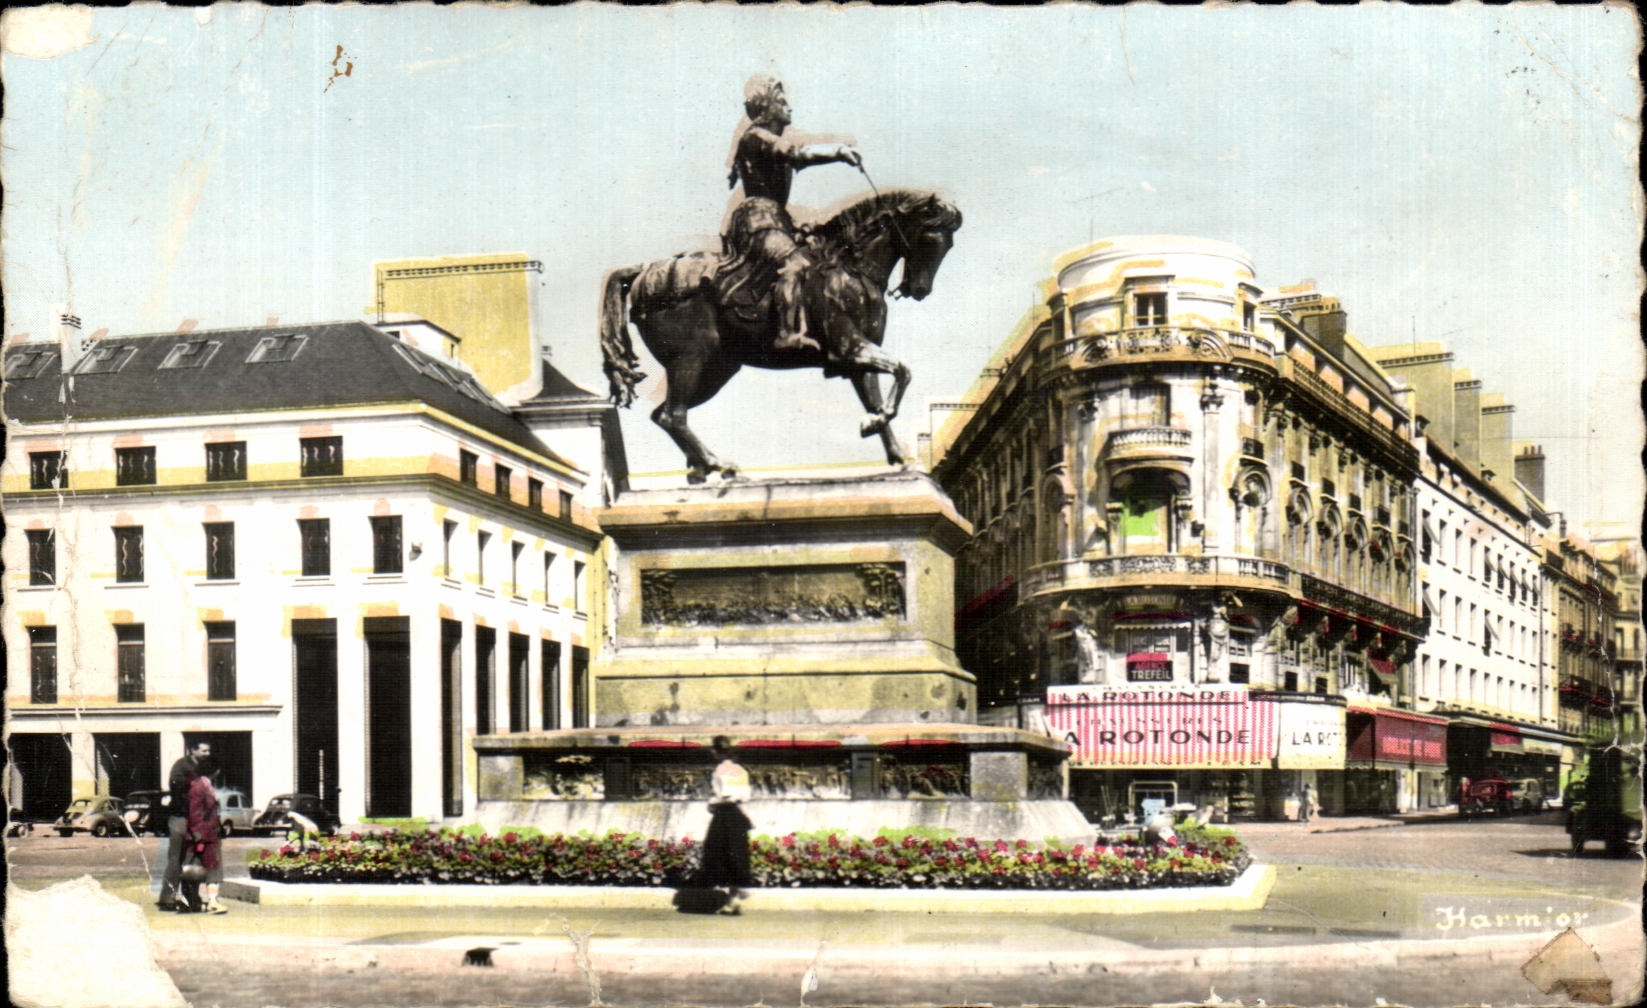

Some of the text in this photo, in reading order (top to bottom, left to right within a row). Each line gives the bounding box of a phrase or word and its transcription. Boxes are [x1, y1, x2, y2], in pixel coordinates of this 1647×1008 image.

[1062, 690, 1232, 702] LA ROTONDE
[1099, 729, 1250, 745] ROTONDE
[1291, 731, 1313, 746] LA
